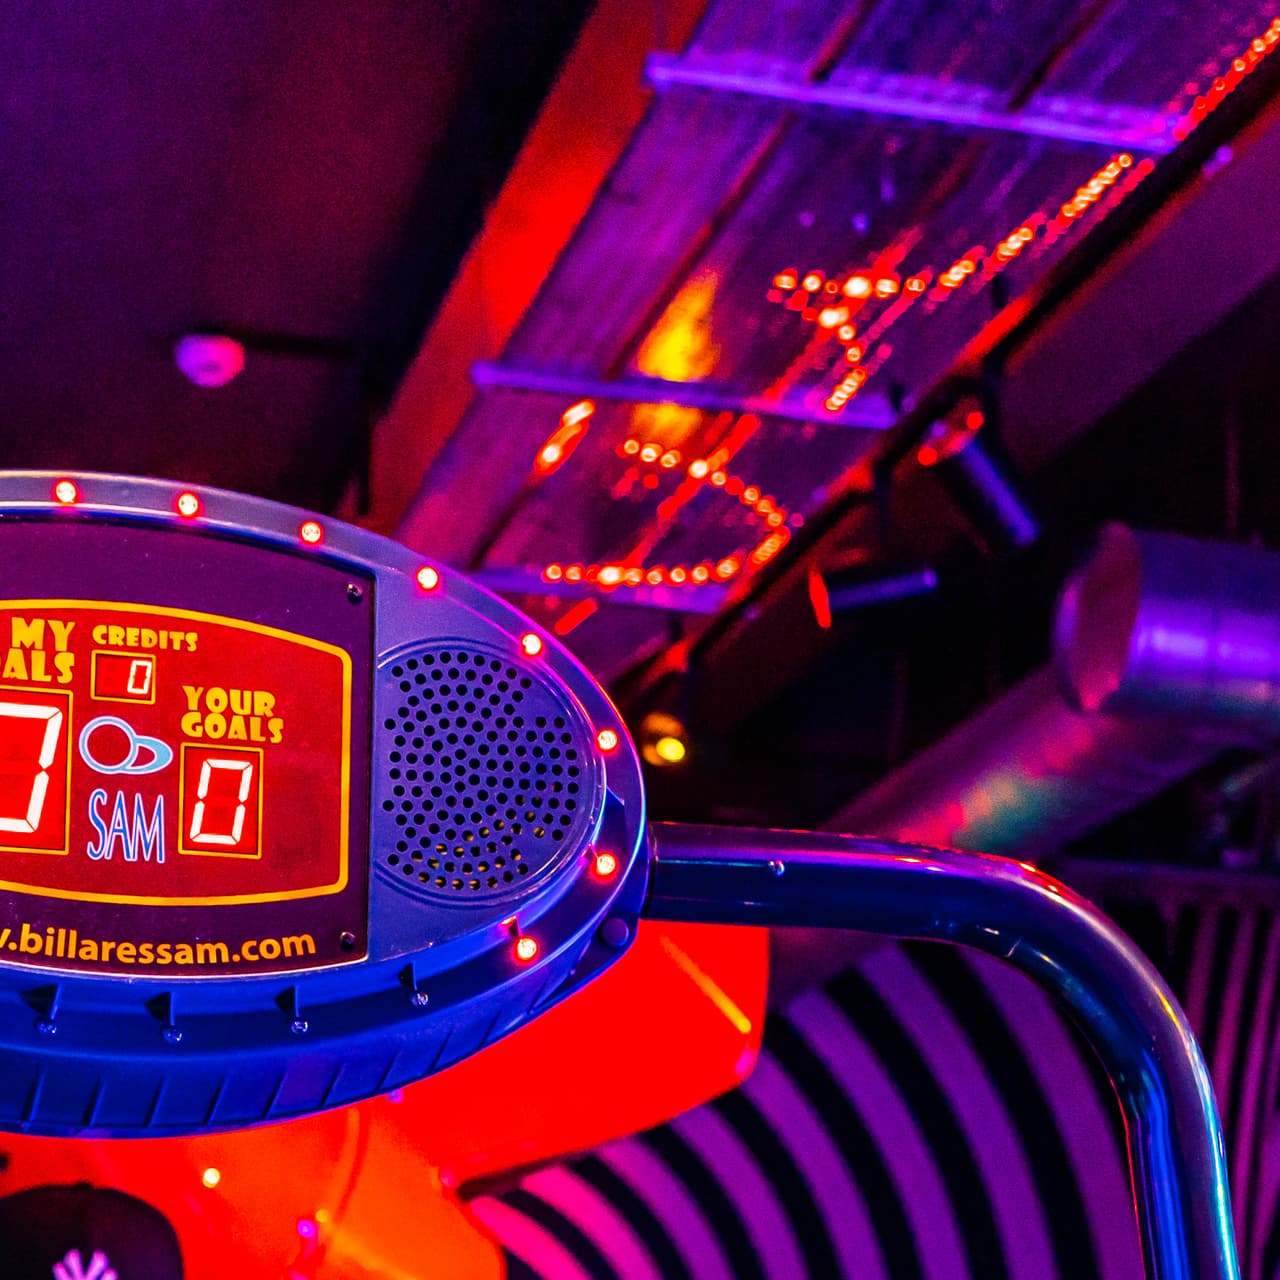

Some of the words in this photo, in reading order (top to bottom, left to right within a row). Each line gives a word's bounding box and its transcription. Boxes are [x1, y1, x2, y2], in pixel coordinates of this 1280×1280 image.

[11, 617, 76, 651] MY
[91, 624, 199, 652] CREDITS
[127, 659, 152, 694] 0
[181, 685, 276, 717] YOUR
[180, 711, 284, 743] GOALS
[190, 758, 253, 845] 0
[87, 788, 165, 863] SAM
